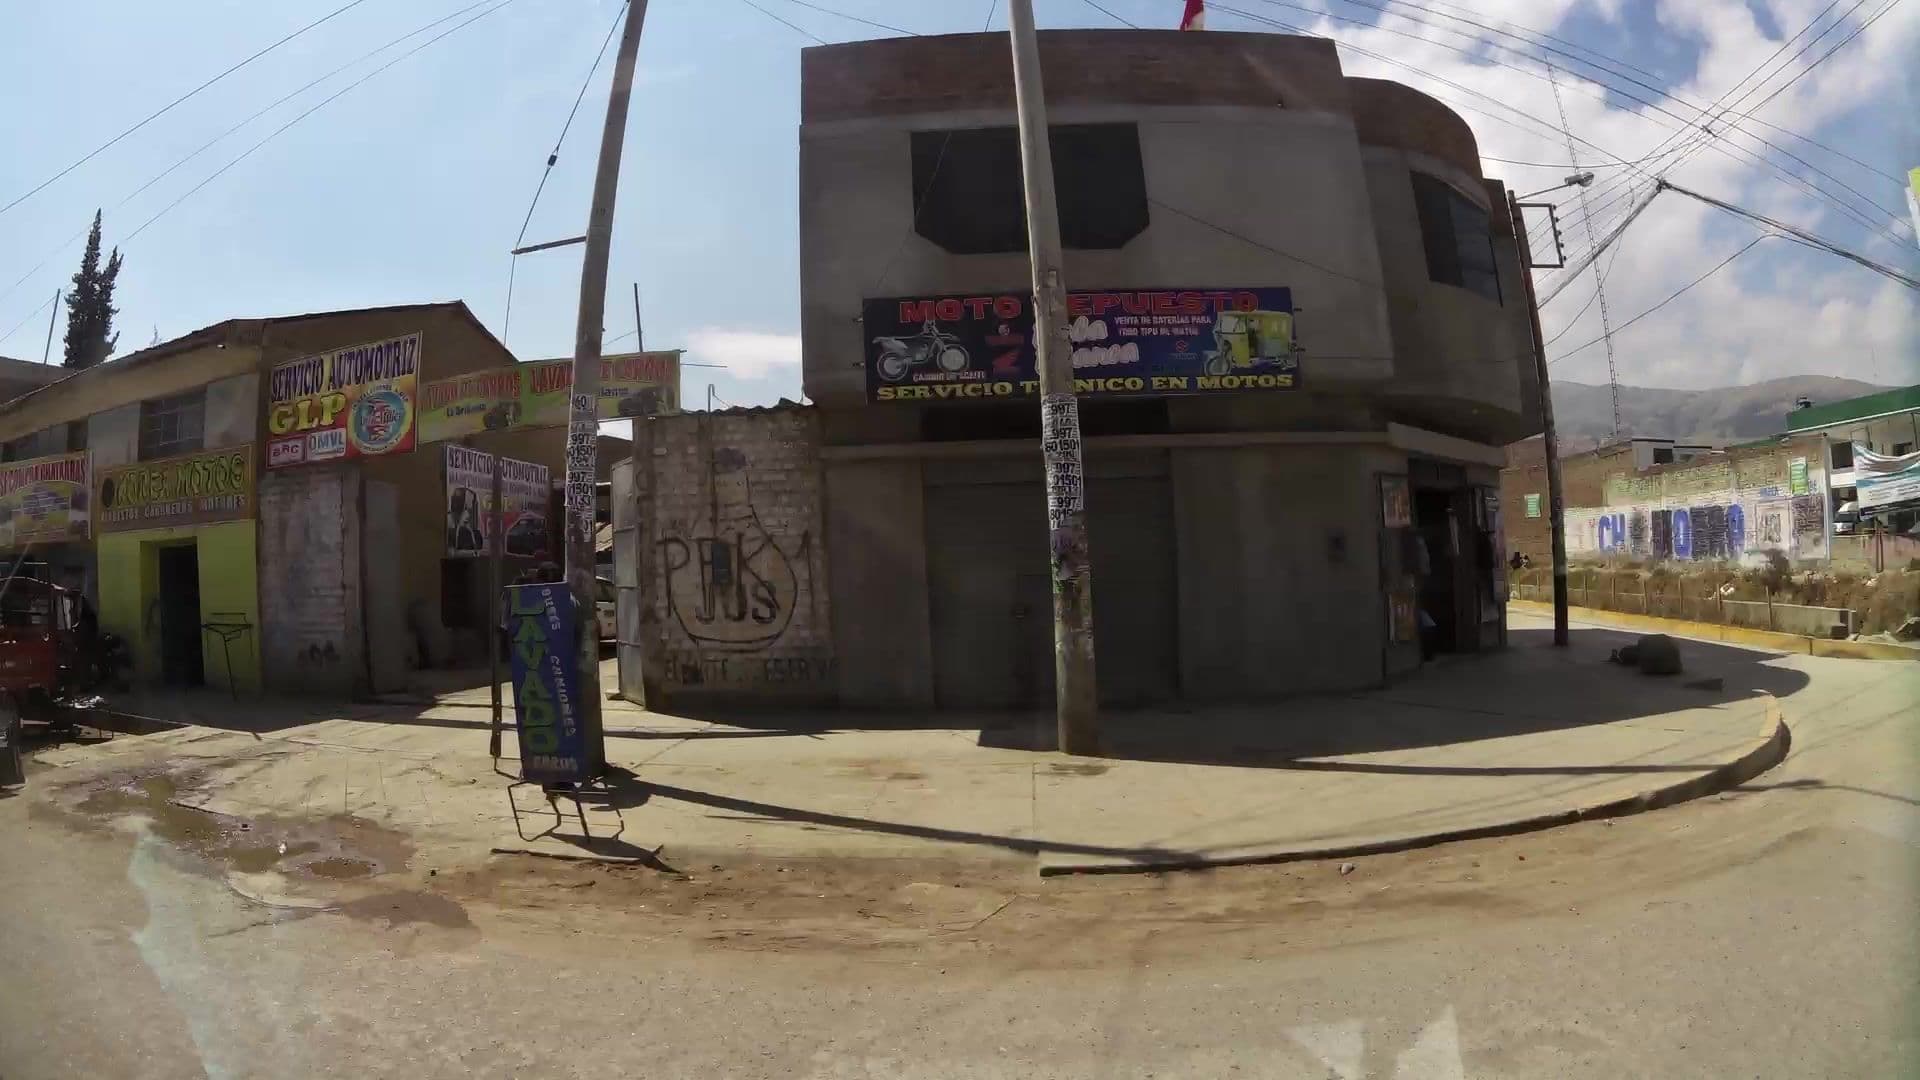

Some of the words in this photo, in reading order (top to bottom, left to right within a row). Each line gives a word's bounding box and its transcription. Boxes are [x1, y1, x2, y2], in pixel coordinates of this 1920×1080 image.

[899, 296, 1022, 323] MOTO
[1067, 290, 1259, 316] EPUESTO
[272, 357, 324, 401] SERVICIO
[328, 337, 417, 391] AUTOMOTRIZ
[877, 381, 1013, 401] SERVICIO
[1151, 375, 1189, 391] EN
[1197, 374, 1293, 391] MOTOS
[270, 392, 346, 435] GLP
